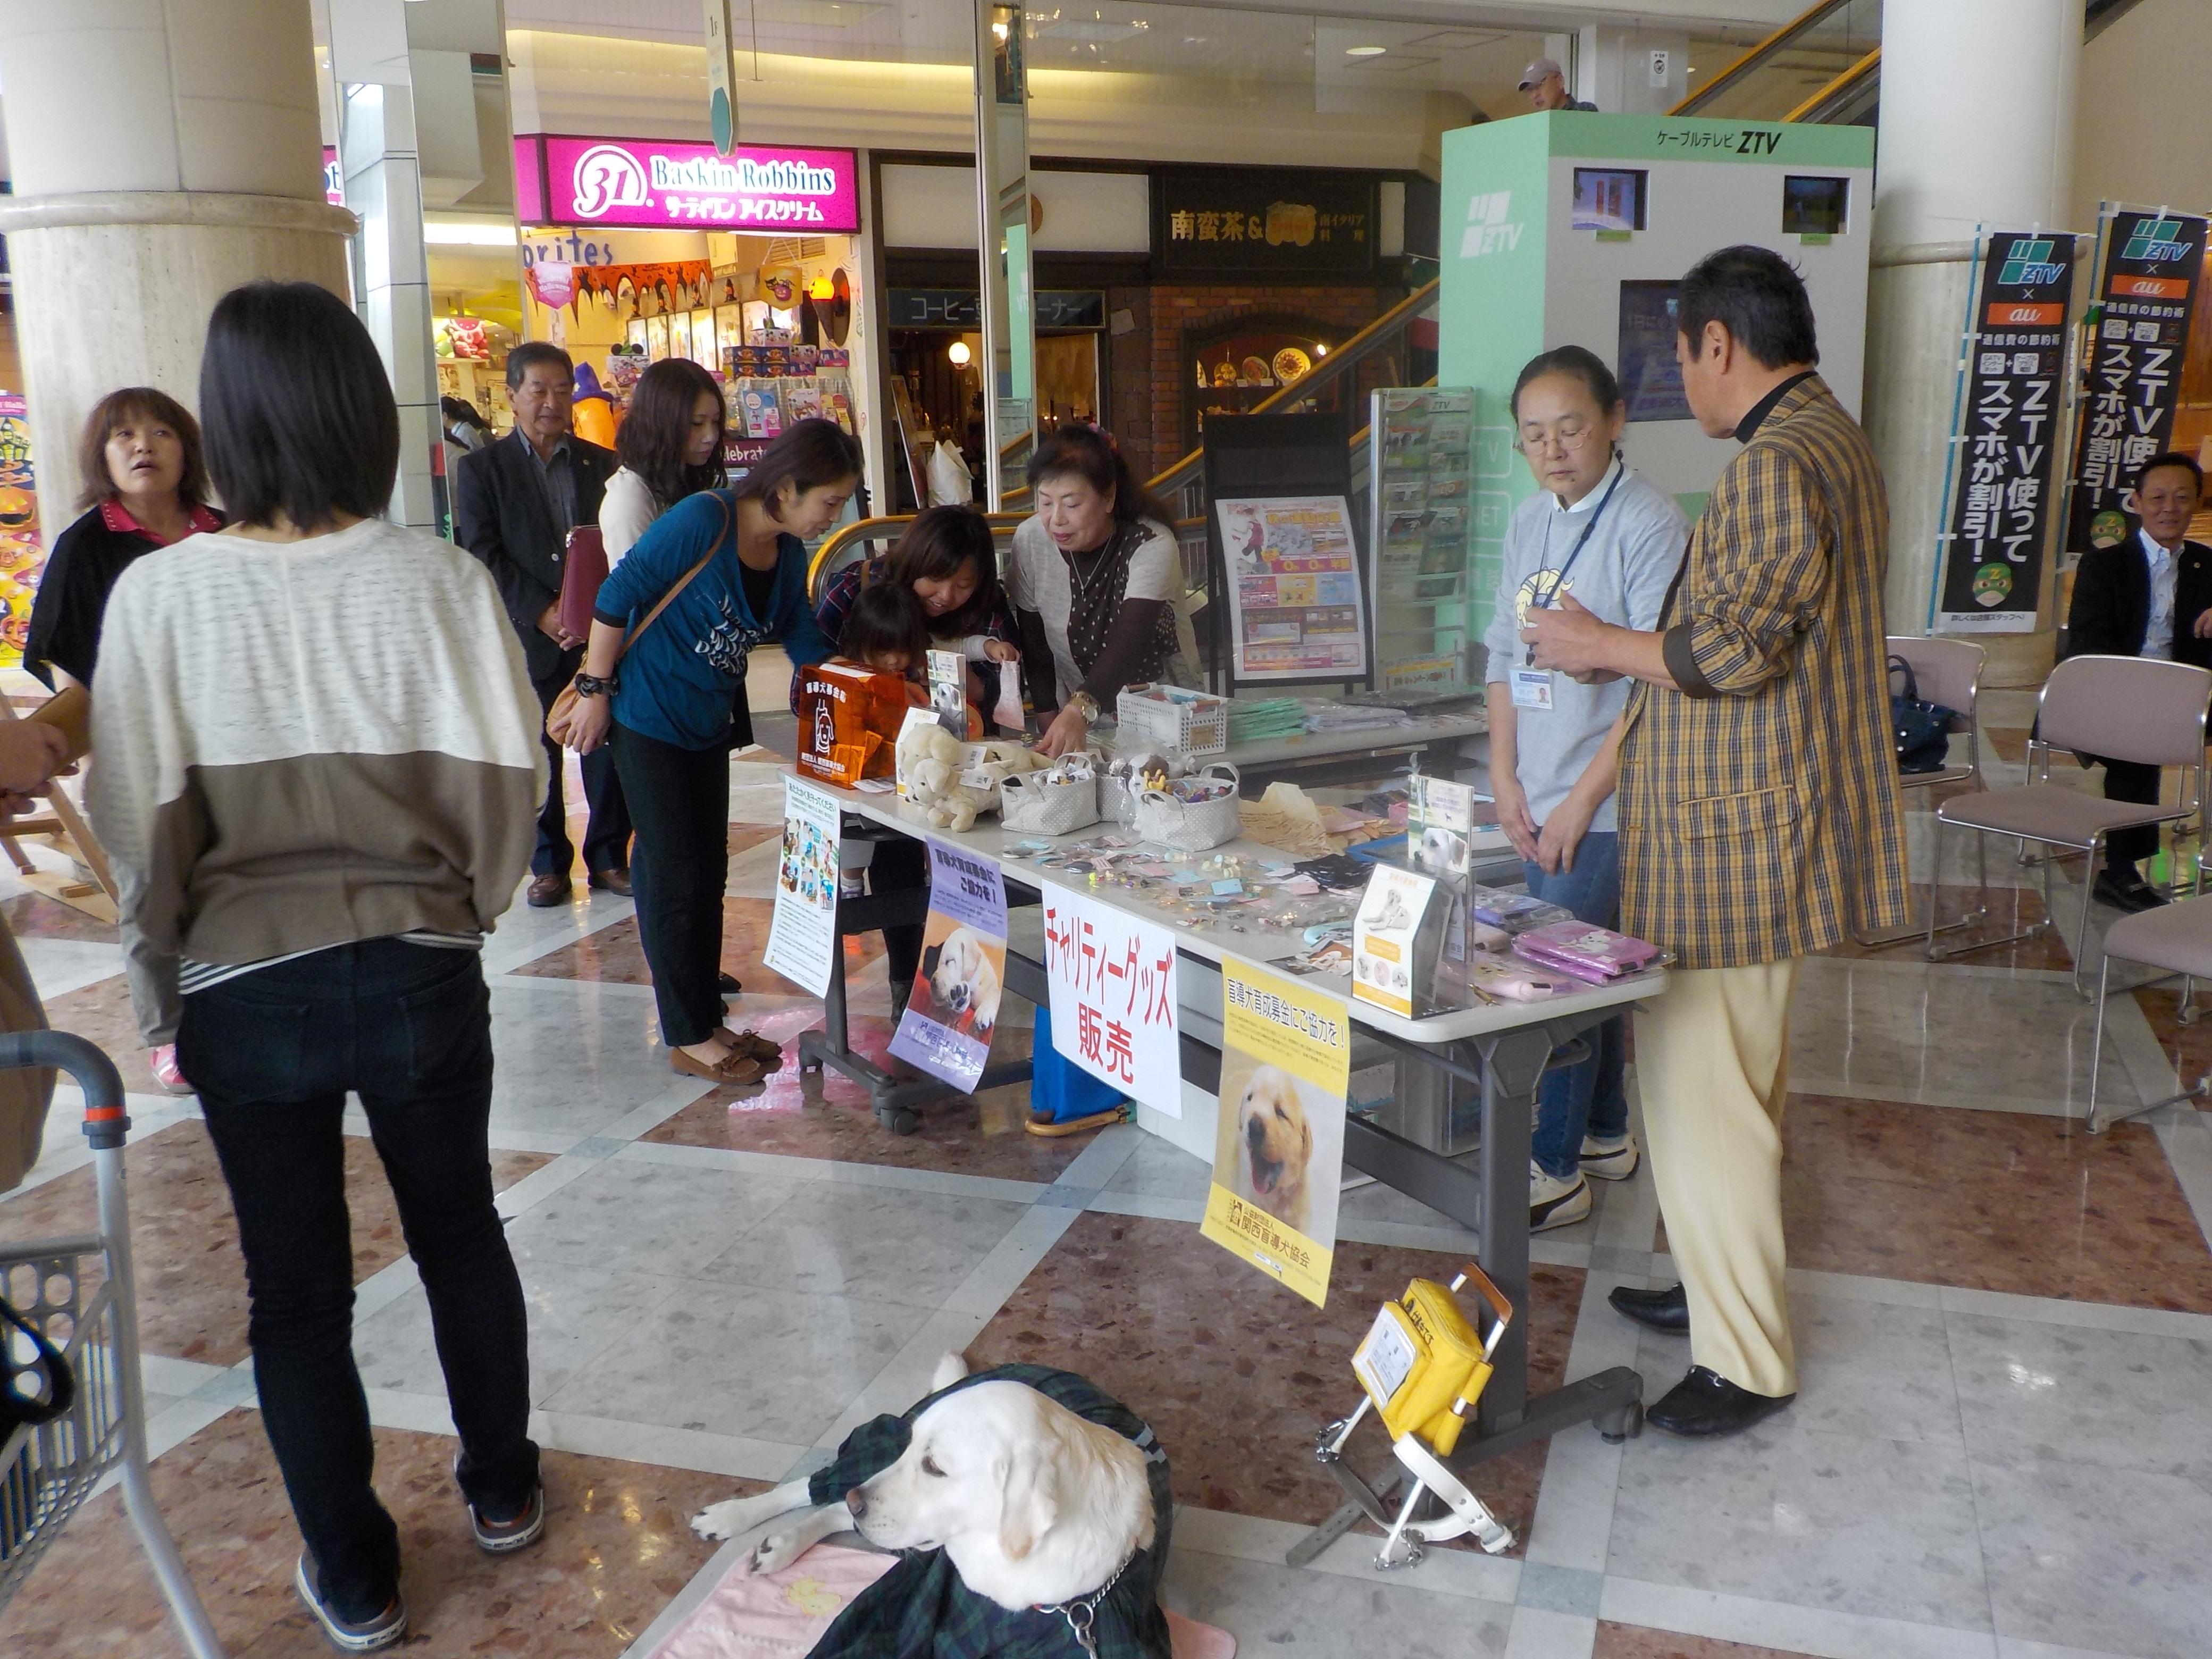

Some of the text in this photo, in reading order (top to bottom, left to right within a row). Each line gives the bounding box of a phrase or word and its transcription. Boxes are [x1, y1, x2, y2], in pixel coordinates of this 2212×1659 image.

[1657, 130, 1783, 155] ケーブルテレビ ZTV
[653, 157, 834, 191] Baskin Robbins
[1480, 222, 1525, 254] ZTV
[2143, 240, 2193, 262] ZTV
[2020, 262, 2067, 284] ZTV
[2132, 281, 2166, 295] au
[2009, 308, 2042, 322] au
[1963, 380, 2014, 563] スマホが割引！
[2002, 381, 2050, 563] ZTV使って
[1046, 907, 1173, 1031] チャリティーグッズ
[1227, 977, 1345, 1049] 盲導犬育成募金にご協力を！
[1078, 1001, 1134, 1085] 販売
[1241, 1214, 1311, 1269] 関西盲導犬協会
